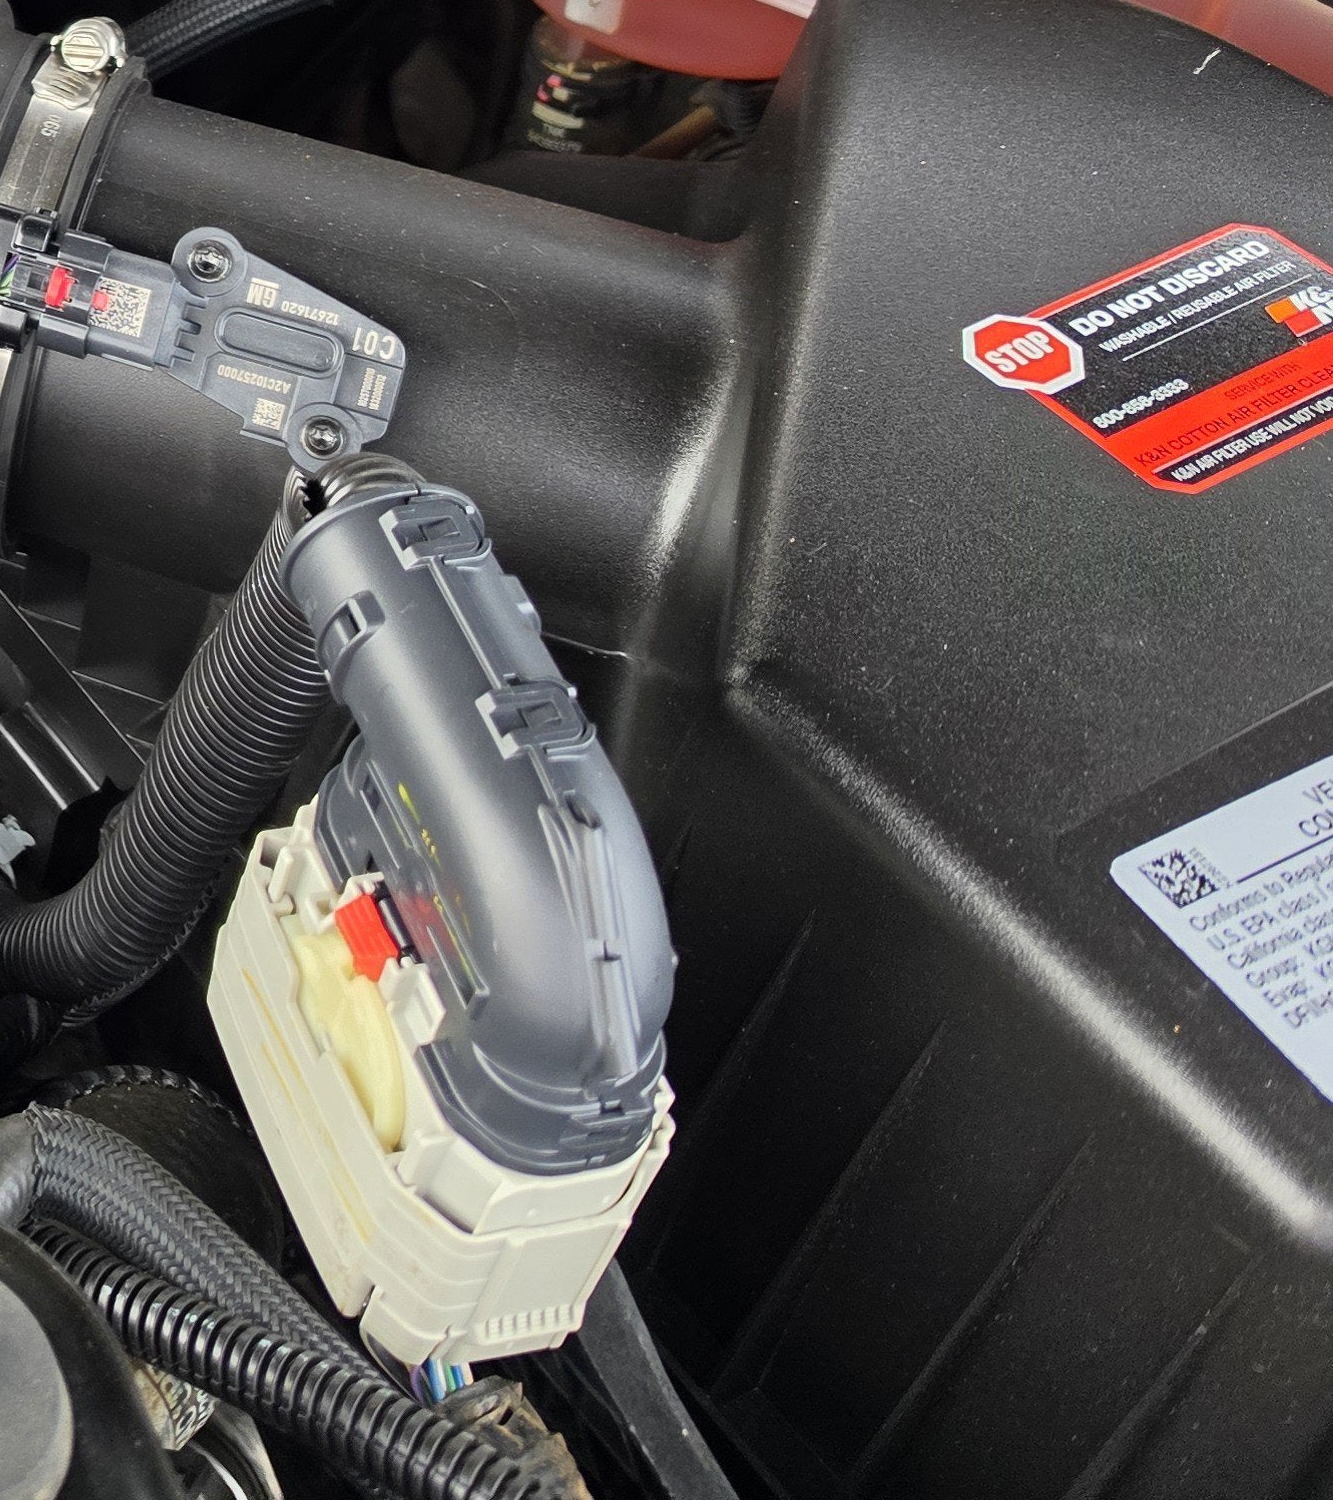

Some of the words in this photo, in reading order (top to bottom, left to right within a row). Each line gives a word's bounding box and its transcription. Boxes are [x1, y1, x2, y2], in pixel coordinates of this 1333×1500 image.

[246, 282, 279, 309] GM
[1068, 309, 1115, 337] DO
[1106, 285, 1165, 319] NOT
[1158, 240, 1270, 296] DISCARD
[1098, 315, 1172, 352] WASHABLE
[1171, 285, 1239, 320] REUSABLE
[1233, 276, 1260, 293] AIR
[1254, 260, 1297, 285] FILTER
[351, 326, 397, 361] C01
[984, 330, 1054, 373] STOP
[1092, 378, 1190, 429] 800-858-3333
[1224, 372, 1274, 402] SERVICE
[1271, 360, 1303, 382] WITH
[1133, 447, 1173, 468] K&N
[1169, 415, 1231, 452] COTTON
[1230, 406, 1254, 425] AIR
[1252, 383, 1300, 411] FILTER
[1171, 463, 1201, 482] K&N
[1194, 453, 1220, 472] AIR
[1213, 438, 1253, 464] FILTER
[1248, 428, 1274, 447] USE
[1265, 417, 1298, 437] WILL
[1289, 407, 1319, 427] NOT
[1189, 890, 1268, 931] Conforms
[1262, 881, 1285, 895] to
[1240, 910, 1281, 936] EPA
